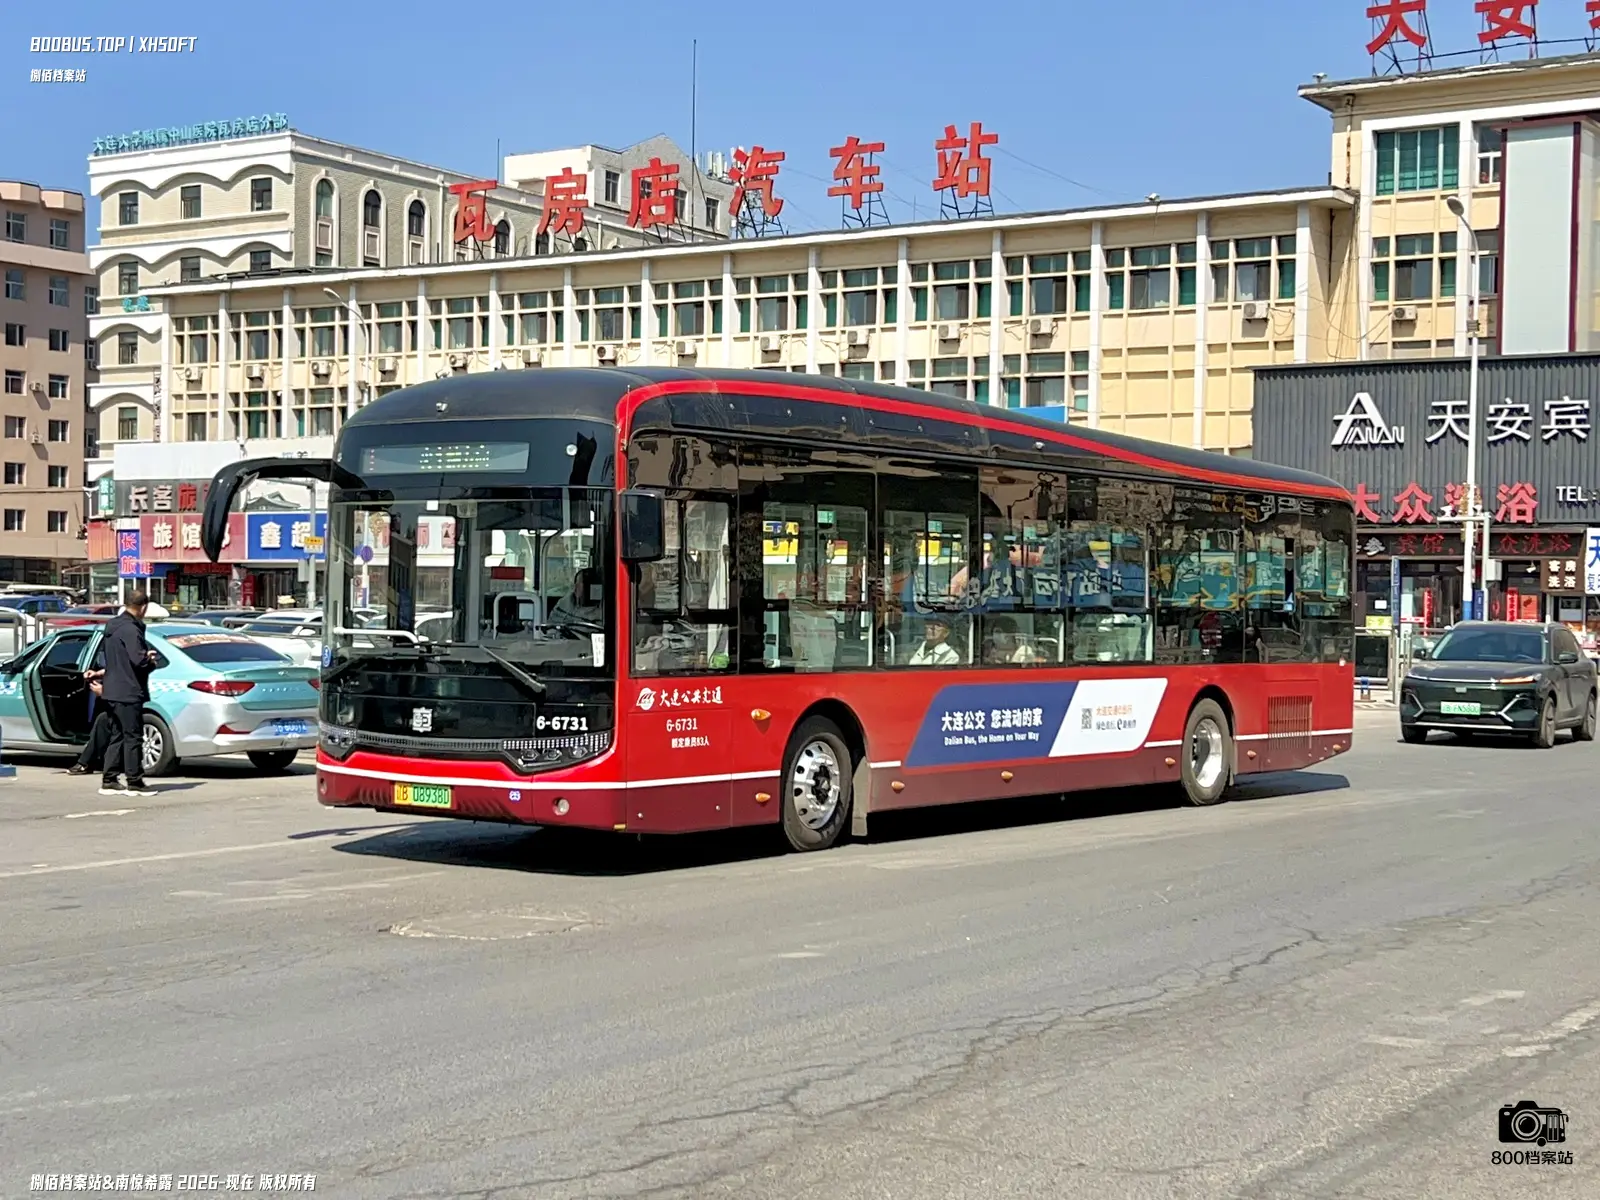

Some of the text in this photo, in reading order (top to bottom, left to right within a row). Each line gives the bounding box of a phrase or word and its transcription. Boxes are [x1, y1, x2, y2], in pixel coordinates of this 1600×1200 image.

[448, 121, 999, 243] 瓦房店汽车站
[129, 484, 210, 512] 长客旅
[1555, 485, 1597, 502] TEL:
[260, 521, 328, 549] 鑫超
[659, 686, 724, 708] 大连公共交通
[536, 716, 589, 731] 6-6731
[666, 718, 698, 732] 6-6731
[941, 707, 1043, 732] 大连公交 您流动的家
[944, 736, 963, 746] Dalian
[977, 735, 988, 744] the
[988, 734, 1005, 743] Home
[1005, 734, 1014, 742] on
[1014, 732, 1027, 741] Your
[1027, 731, 1040, 742] Way
